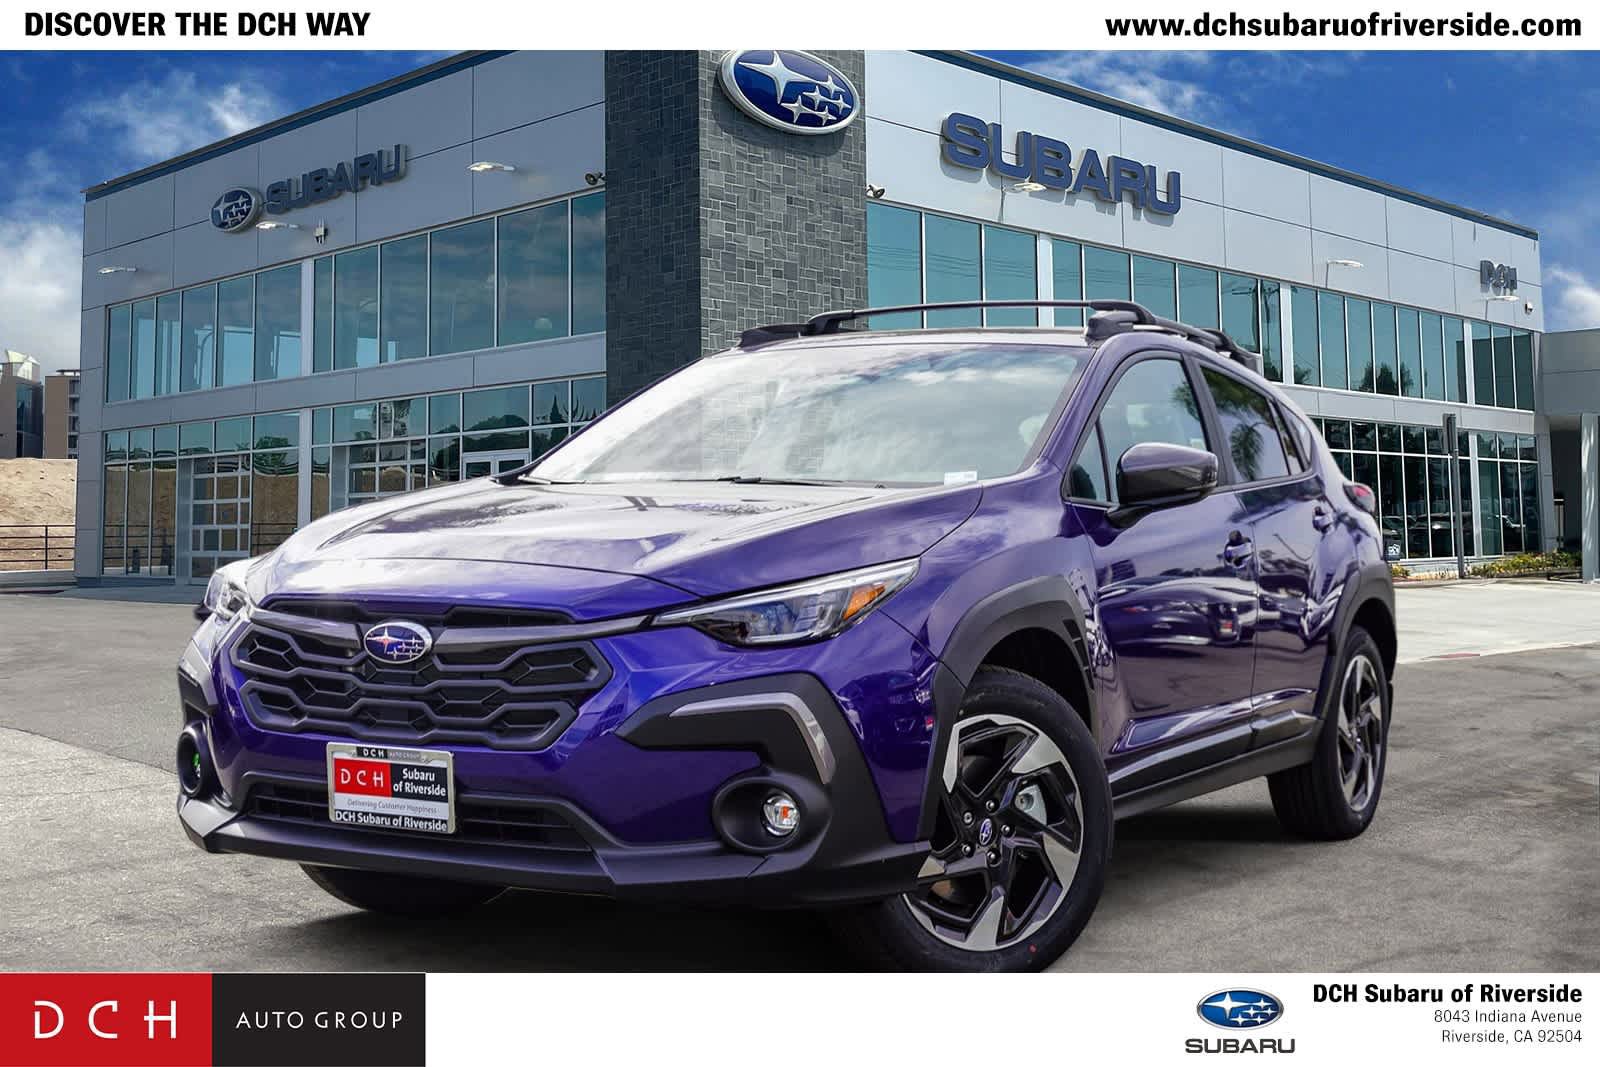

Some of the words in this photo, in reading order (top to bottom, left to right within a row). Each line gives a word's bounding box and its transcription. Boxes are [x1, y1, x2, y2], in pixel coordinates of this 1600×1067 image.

[941, 112, 1182, 215] SUBARU
[266, 144, 407, 214] SUBARU
[362, 748, 385, 757] DCH
[340, 768, 384, 788] DCH
[402, 768, 435, 781] Subaru
[393, 781, 403, 792] of
[404, 783, 446, 797] Riverside
[335, 810, 356, 822] DCH
[357, 813, 391, 826] Subaru
[392, 816, 402, 827] of
[404, 817, 447, 832] Riverside
